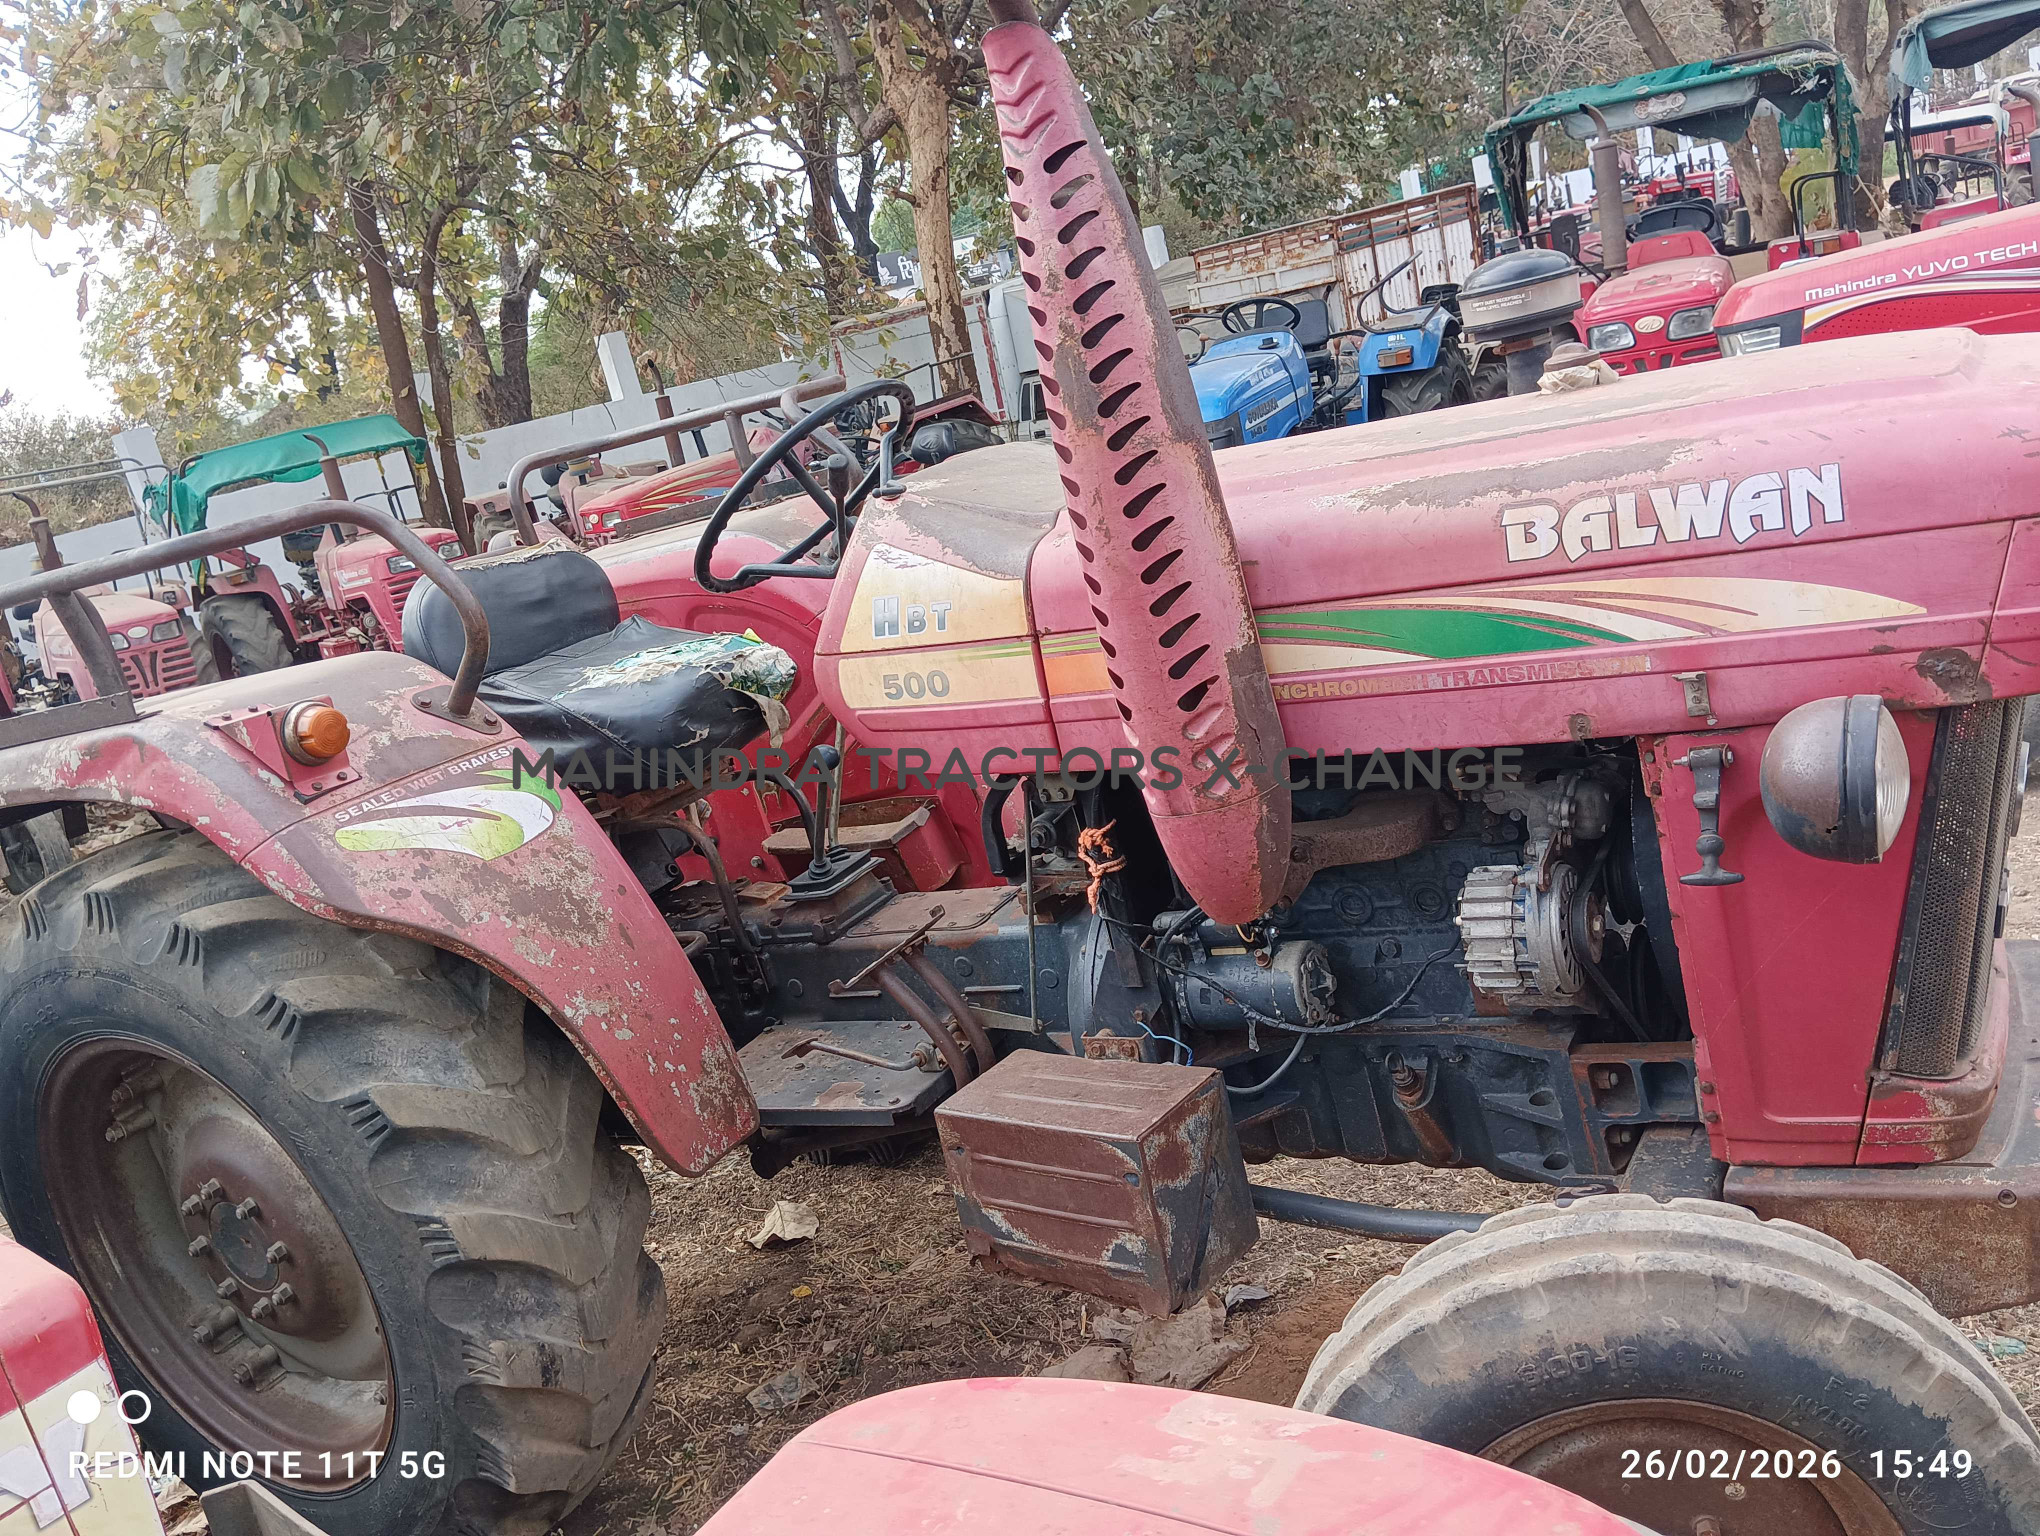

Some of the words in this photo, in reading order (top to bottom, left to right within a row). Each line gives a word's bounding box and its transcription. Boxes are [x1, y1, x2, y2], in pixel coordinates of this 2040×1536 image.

[1804, 272, 1897, 302] Mahindra
[1901, 254, 1970, 280] YUVO
[1973, 240, 2038, 264] TECH
[1500, 299, 1523, 307] REACHES
[1500, 462, 1845, 563] BALWAN
[872, 595, 952, 640] HBT
[882, 669, 950, 701] 500
[1273, 673, 1430, 700] NCHROMESH
[1437, 655, 1650, 688] TRANSMISSION
[334, 787, 406, 824] SEALED
[407, 768, 446, 793] WET
[448, 745, 510, 777] BRAKES
[1700, 1363, 1744, 1378] RATING
[1702, 1351, 1722, 1361] PLY
[1792, 1394, 1868, 1439] NYLON
